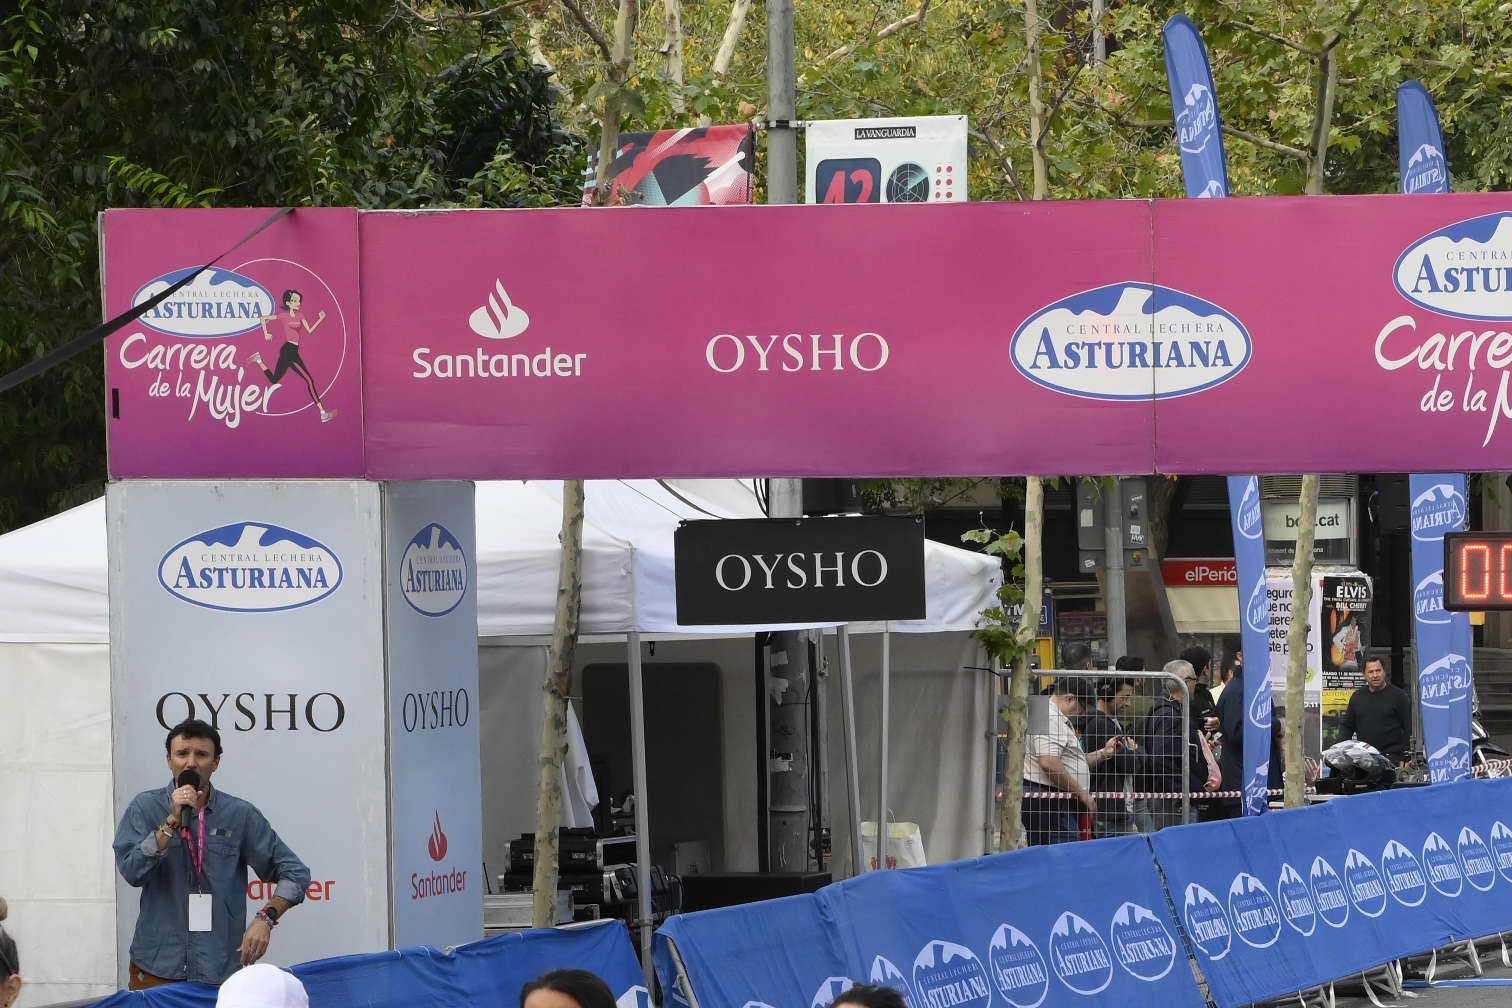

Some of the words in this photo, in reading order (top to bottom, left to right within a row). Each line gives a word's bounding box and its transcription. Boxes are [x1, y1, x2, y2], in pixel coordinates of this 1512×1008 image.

[856, 129, 867, 138] LA
[866, 128, 915, 138] VANGUARDIA
[171, 289, 211, 298] ENTRAL
[1066, 323, 1141, 335] CENTRAL
[1149, 322, 1225, 334] LECHERA
[119, 332, 238, 370] Carrera
[413, 346, 588, 378] Santander
[705, 332, 890, 373] OYSHO
[1029, 326, 1233, 369] ASTURIANA
[149, 371, 171, 398] de
[175, 371, 191, 398] la
[187, 366, 283, 428] Mujer
[1420, 374, 1454, 413] de
[1463, 372, 1488, 413] la
[173, 555, 330, 590] ASTURIANA
[201, 553, 260, 562] CENTRAL
[264, 553, 323, 563] LECHERA
[715, 549, 889, 591] OYSHO
[1184, 564, 1238, 583] elPerió
[405, 558, 464, 593] ASTURIANA
[1336, 586, 1367, 599] ELVIS
[155, 692, 346, 732] OYSHO
[402, 687, 470, 733] OYSHO
[410, 867, 467, 900] Santander
[1232, 901, 1279, 932] ASTURIANA
[1055, 945, 1110, 978] ASTURIANA
[1116, 934, 1172, 965] ASTURIANA
[994, 959, 1047, 992] ASTURIANA
